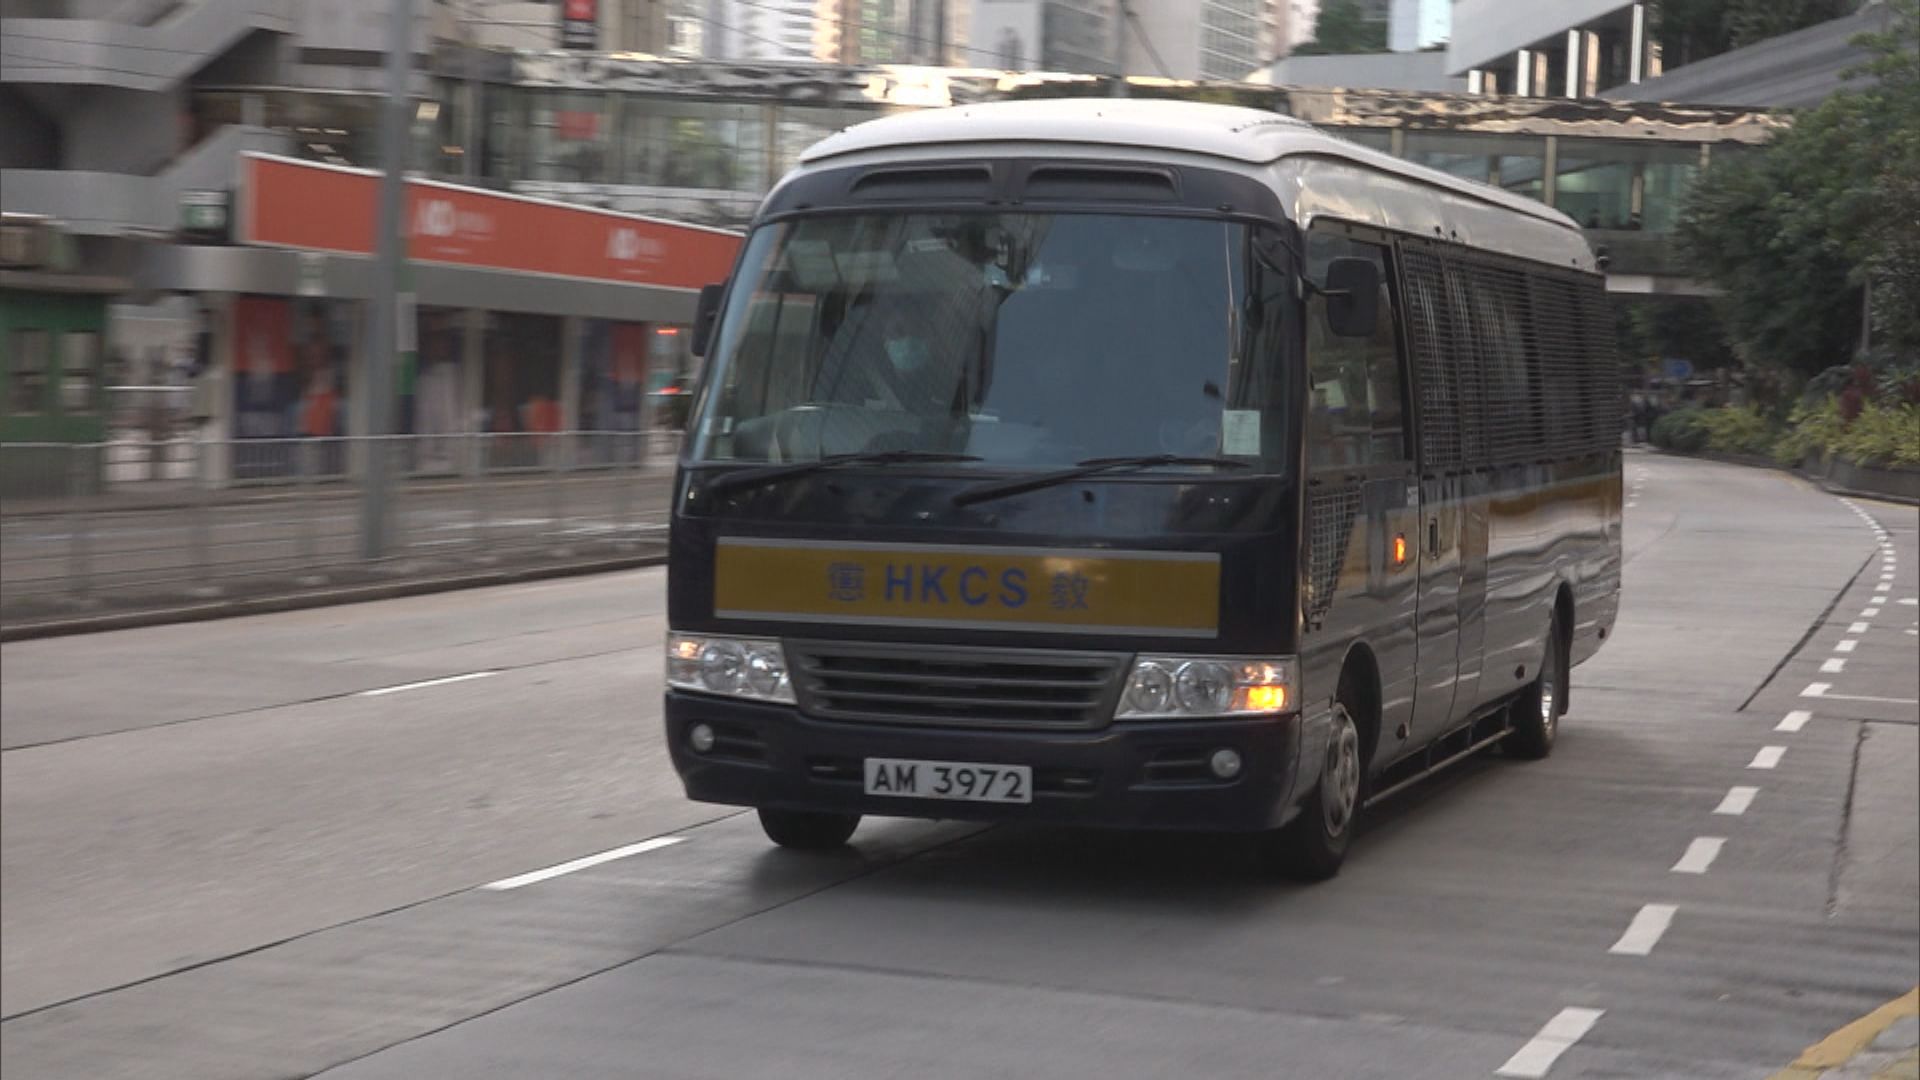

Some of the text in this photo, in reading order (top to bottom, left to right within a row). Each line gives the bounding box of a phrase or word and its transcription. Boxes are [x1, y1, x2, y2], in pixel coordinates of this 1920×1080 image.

[885, 564, 1029, 608] HKCS
[872, 764, 1024, 799] AM 3972
